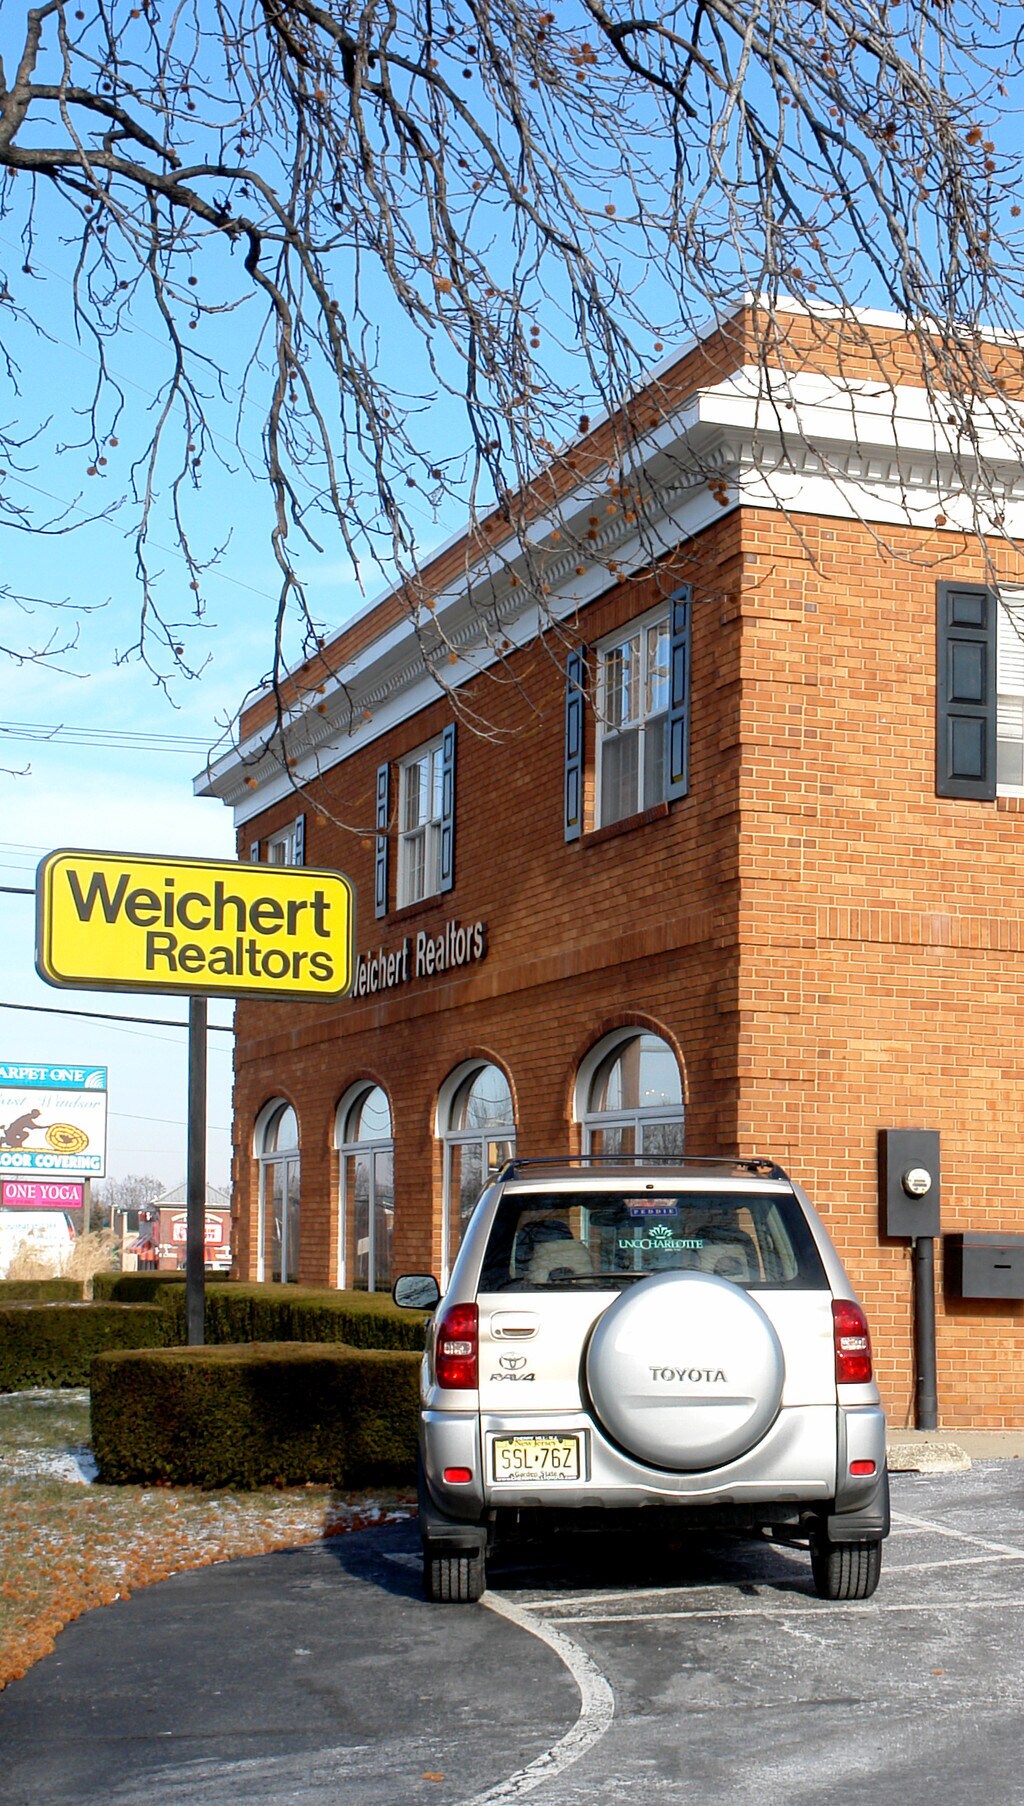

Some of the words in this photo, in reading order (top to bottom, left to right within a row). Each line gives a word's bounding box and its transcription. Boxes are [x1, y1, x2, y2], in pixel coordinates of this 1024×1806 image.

[66, 869, 331, 938] Weichert
[146, 931, 334, 982] Realtors
[416, 919, 484, 977] Realtors
[49, 1068, 87, 1082] ONE
[0, 1152, 33, 1168] OOR
[34, 1154, 100, 1169] COVERING
[5, 1184, 36, 1199] ONE
[40, 1185, 79, 1200] YOGA
[490, 1373, 536, 1382] RAV4
[648, 1366, 728, 1383] TOYOTA
